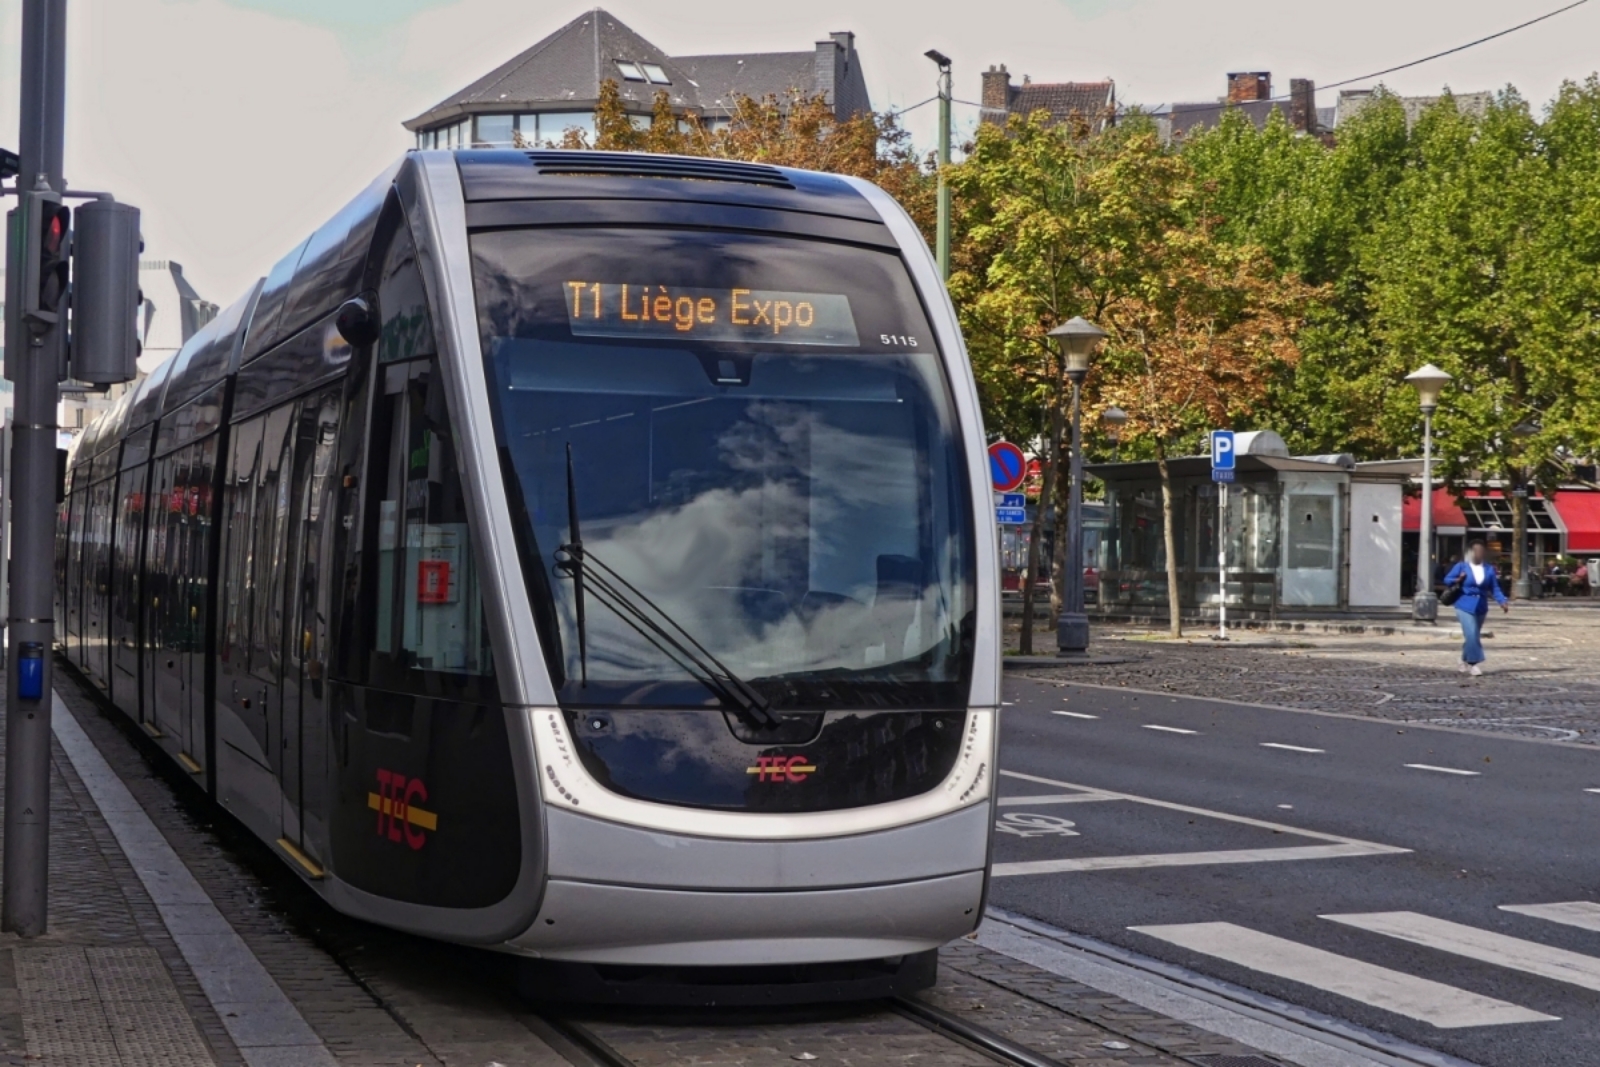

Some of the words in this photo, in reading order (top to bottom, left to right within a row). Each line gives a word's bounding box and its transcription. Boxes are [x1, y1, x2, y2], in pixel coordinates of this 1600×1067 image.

[568, 281, 601, 319] T1
[621, 283, 716, 331] Liège
[731, 288, 814, 334] Expo
[880, 334, 918, 347] 5115
[1215, 437, 1231, 463] P
[1215, 471, 1234, 480] TAXIS
[757, 756, 808, 782] TEC
[376, 768, 428, 850] TEC
